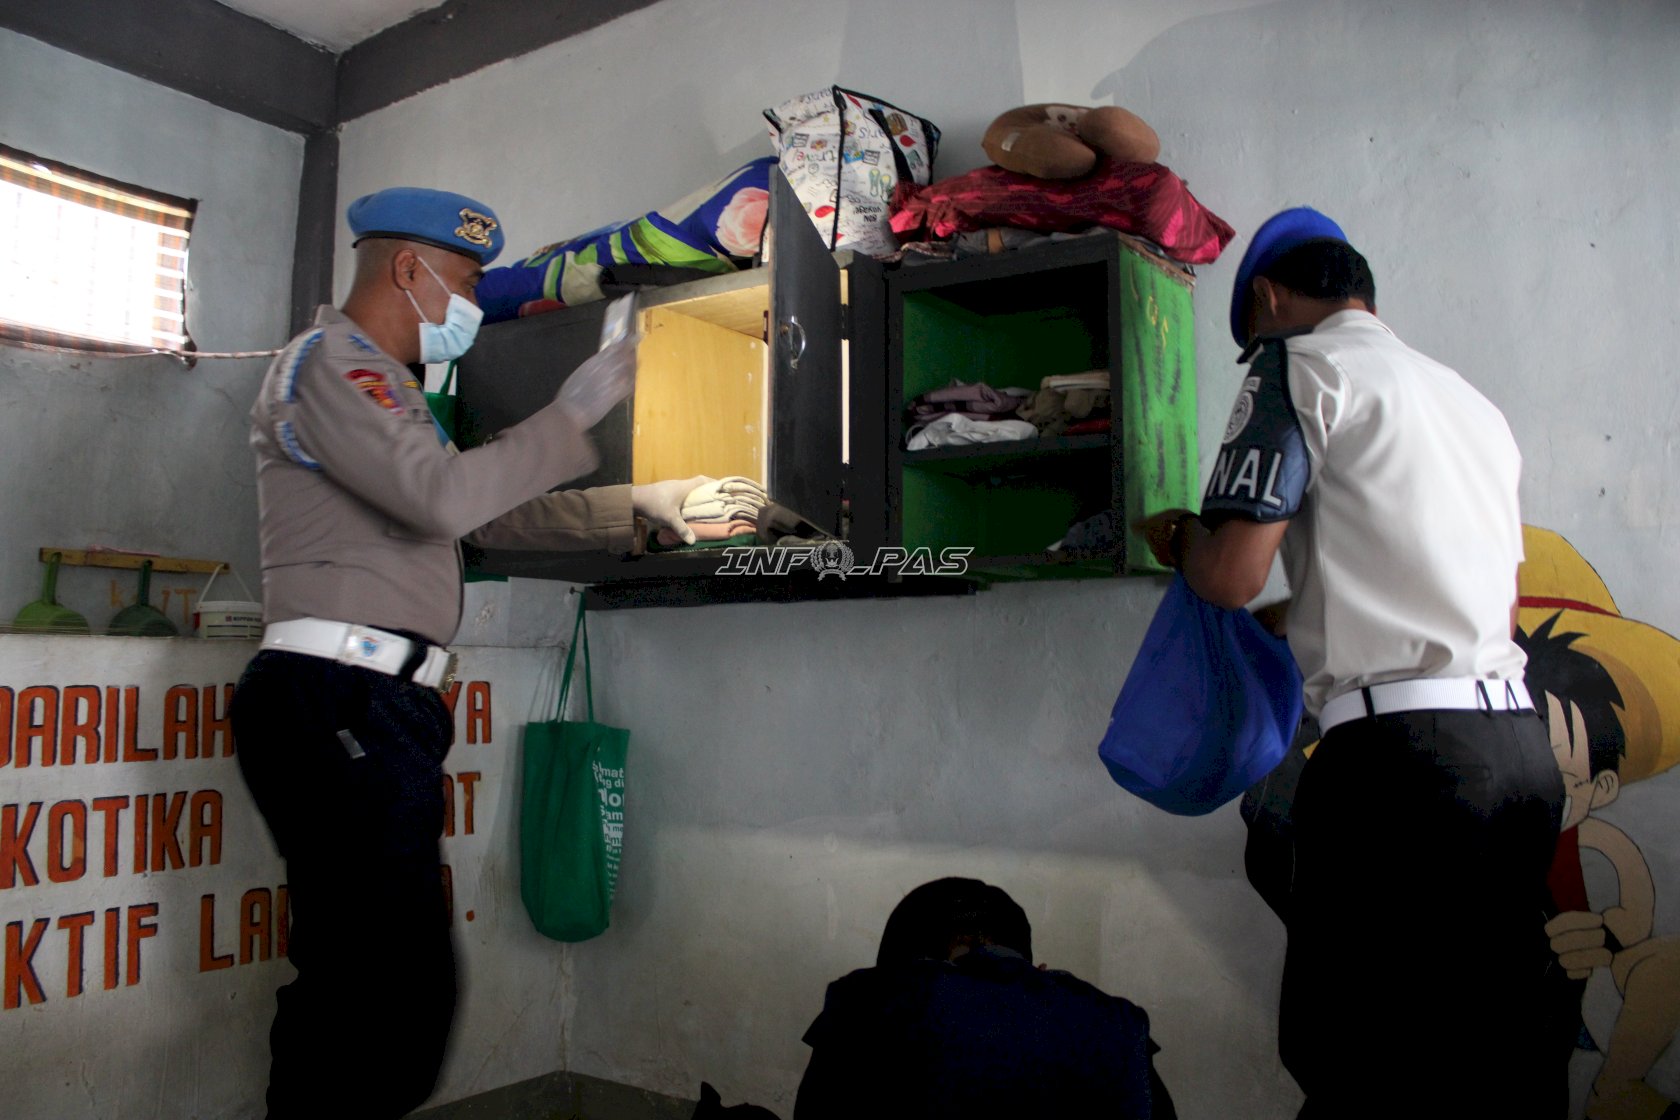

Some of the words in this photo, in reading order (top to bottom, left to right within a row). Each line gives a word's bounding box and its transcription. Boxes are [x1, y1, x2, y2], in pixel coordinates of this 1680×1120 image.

[1208, 448, 1283, 507] NAL
[0, 789, 223, 889] KOTIKA
[3, 902, 158, 1010] KTIF
